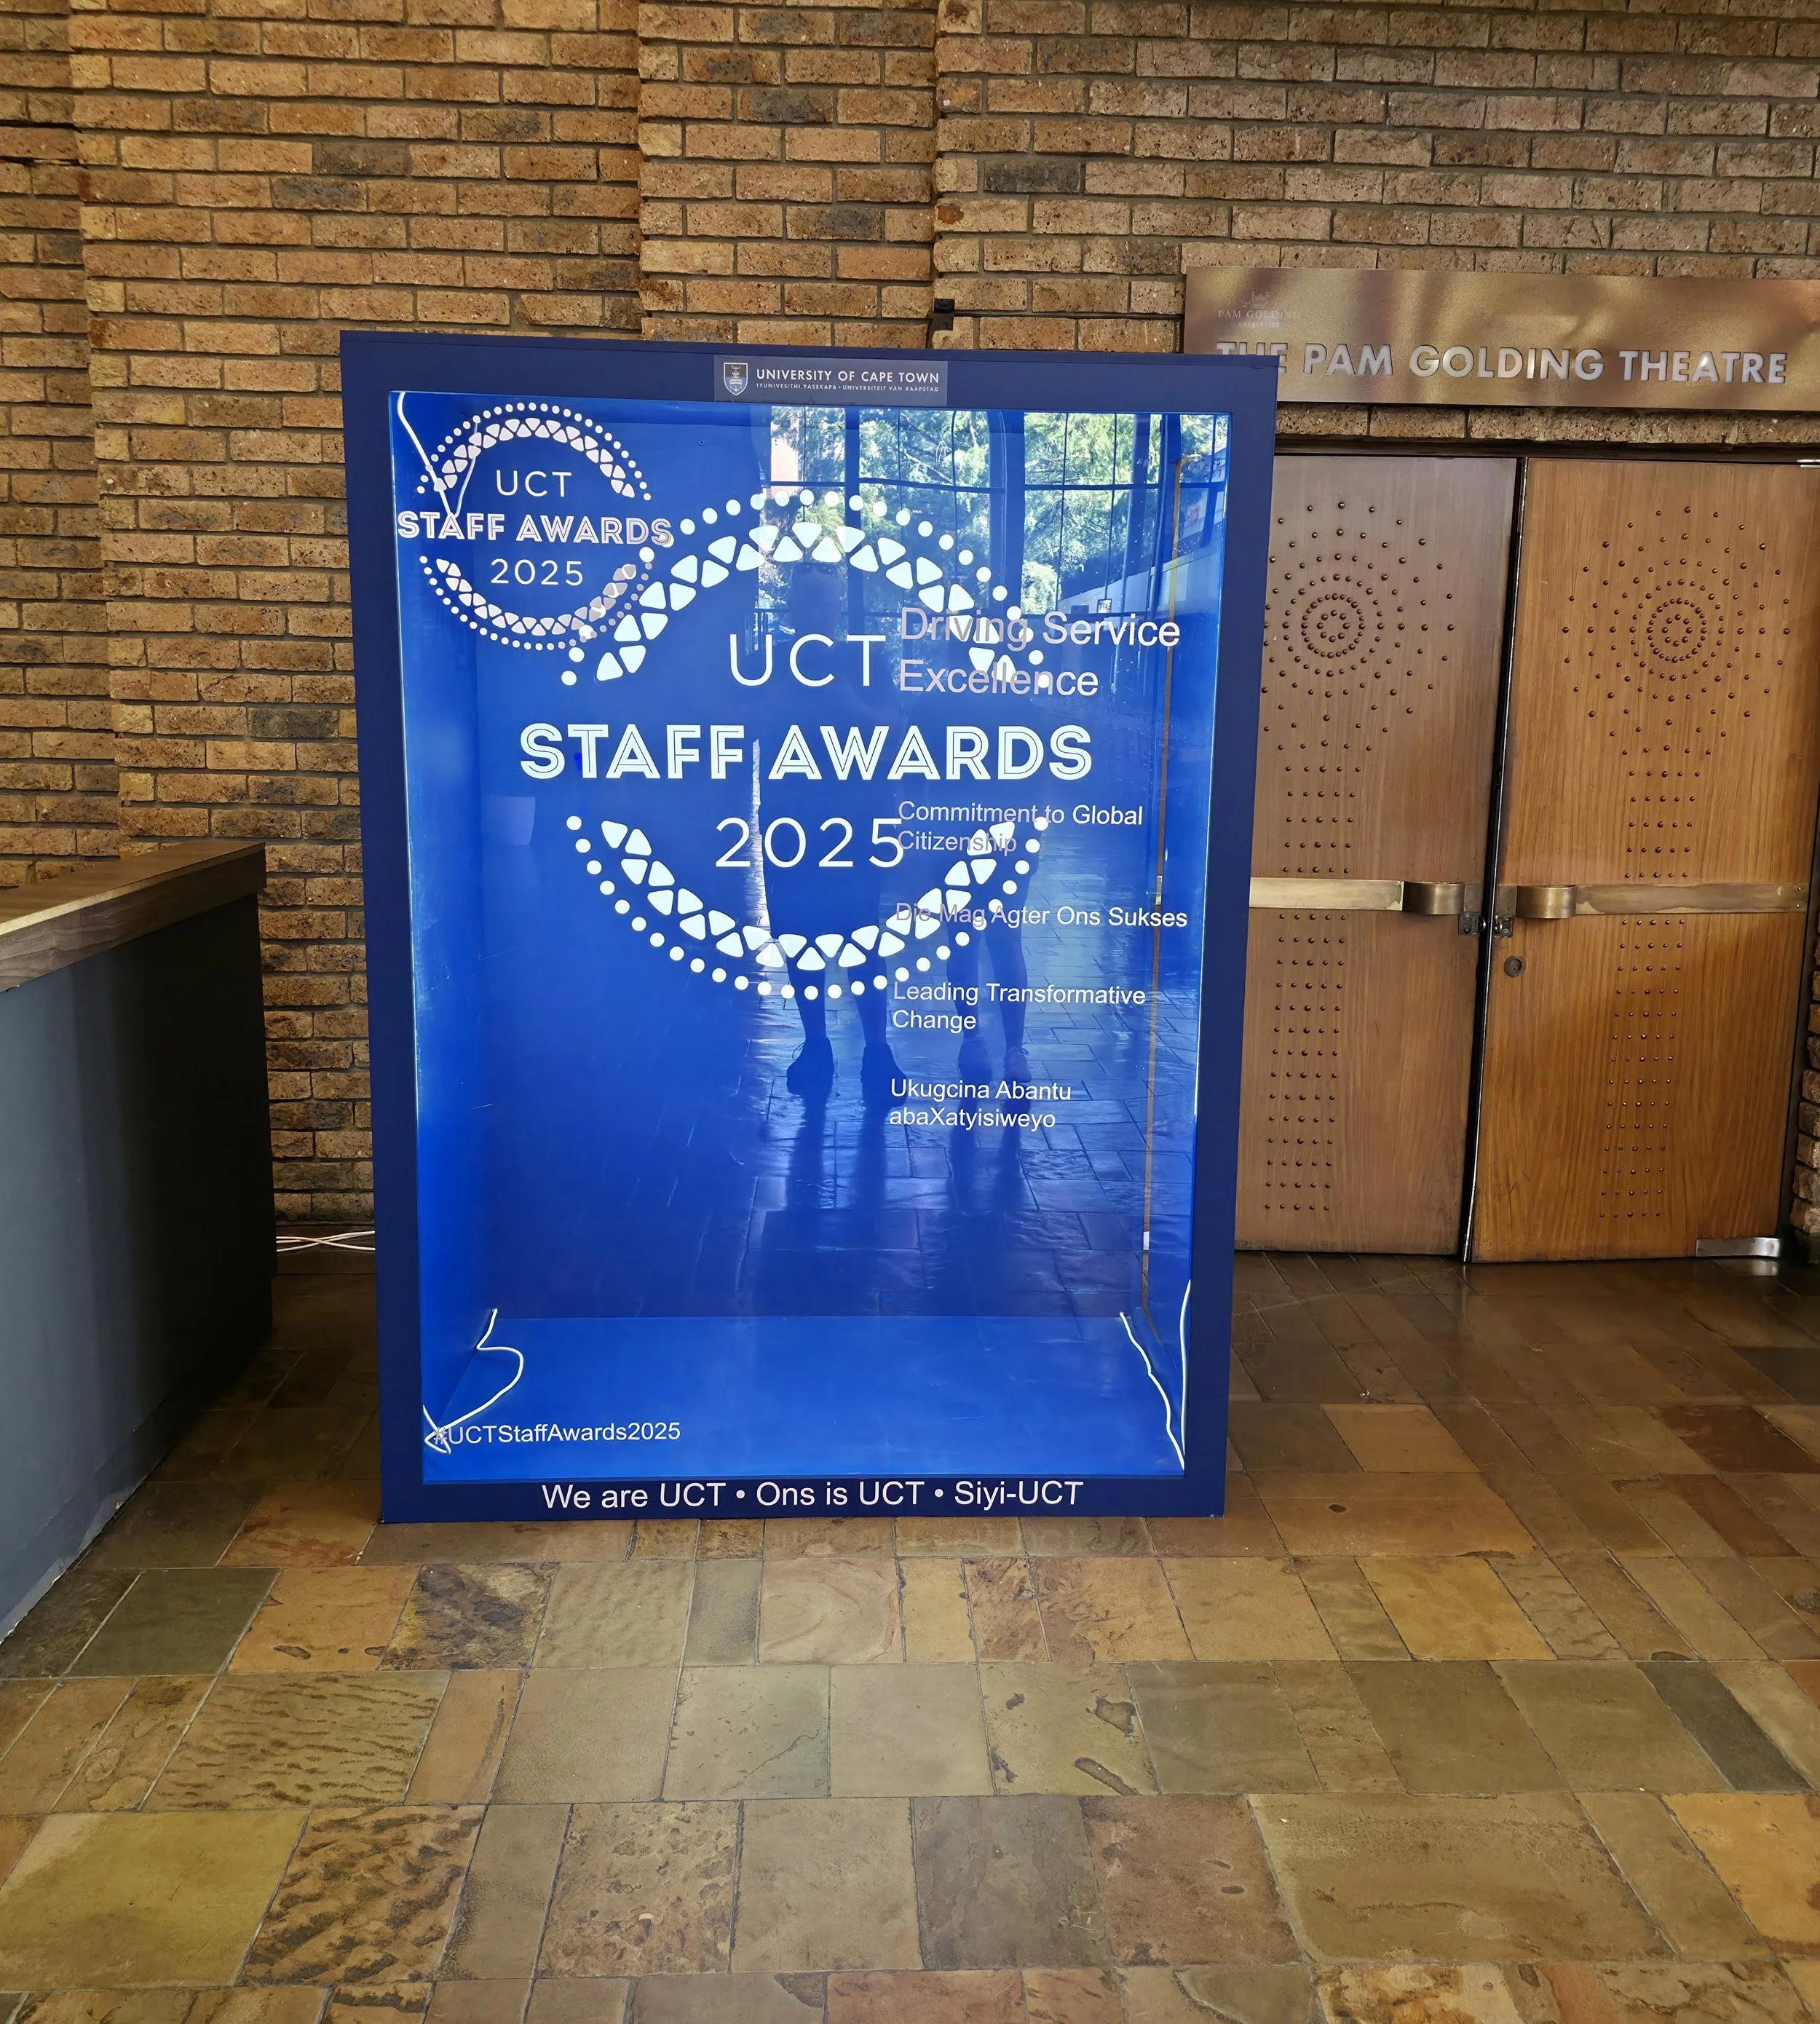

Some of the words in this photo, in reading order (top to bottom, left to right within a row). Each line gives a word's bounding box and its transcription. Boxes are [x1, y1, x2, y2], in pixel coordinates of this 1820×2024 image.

[1218, 309, 1241, 319] PAM
[1246, 309, 1301, 320] GOLDING
[756, 368, 832, 381] UNIVERSITY
[838, 371, 855, 382] OF
[861, 371, 893, 382] CAPE
[898, 372, 939, 383] TOWN
[1303, 343, 1393, 376] PAM
[1409, 344, 1605, 381] GOLDING
[1619, 350, 1787, 384] THEATRE
[496, 470, 571, 497] UCT
[397, 511, 505, 541] STAFF
[516, 515, 672, 545] AWARDS
[491, 558, 583, 586] 2025
[901, 606, 1028, 652] Driving
[1042, 612, 1181, 647] Service
[729, 633, 887, 688] UCT
[900, 659, 1099, 696] Excellence
[520, 723, 744, 780] STAFF
[769, 724, 1092, 780] AWARDS
[898, 800, 1038, 823] Commitment
[1044, 806, 1065, 824] to
[1072, 805, 1143, 826] Global
[715, 816, 904, 869] 2025
[898, 830, 1017, 856] Citizenship
[896, 902, 931, 922] Die
[940, 904, 985, 928] Mag
[991, 905, 1050, 928] Agter
[1057, 906, 1101, 926] Ons
[1108, 906, 1188, 928] Sukses
[893, 982, 978, 1005] Leading
[986, 983, 1146, 1005] Transformative
[892, 1009, 977, 1034] Change
[891, 1078, 989, 1102] Ukugcina
[995, 1080, 1072, 1100] Abantu
[890, 1107, 1056, 1132] abaXatyisiweyo
[434, 1422, 681, 1445] #UCTStaffAwards2025
[541, 1484, 591, 1509] We
[601, 1489, 649, 1508] are
[660, 1482, 727, 1508] UCT
[756, 1482, 815, 1507] Ons
[826, 1481, 848, 1506] is
[859, 1480, 925, 1506] UCT
[954, 1480, 1085, 1511] Siyi-UCT
